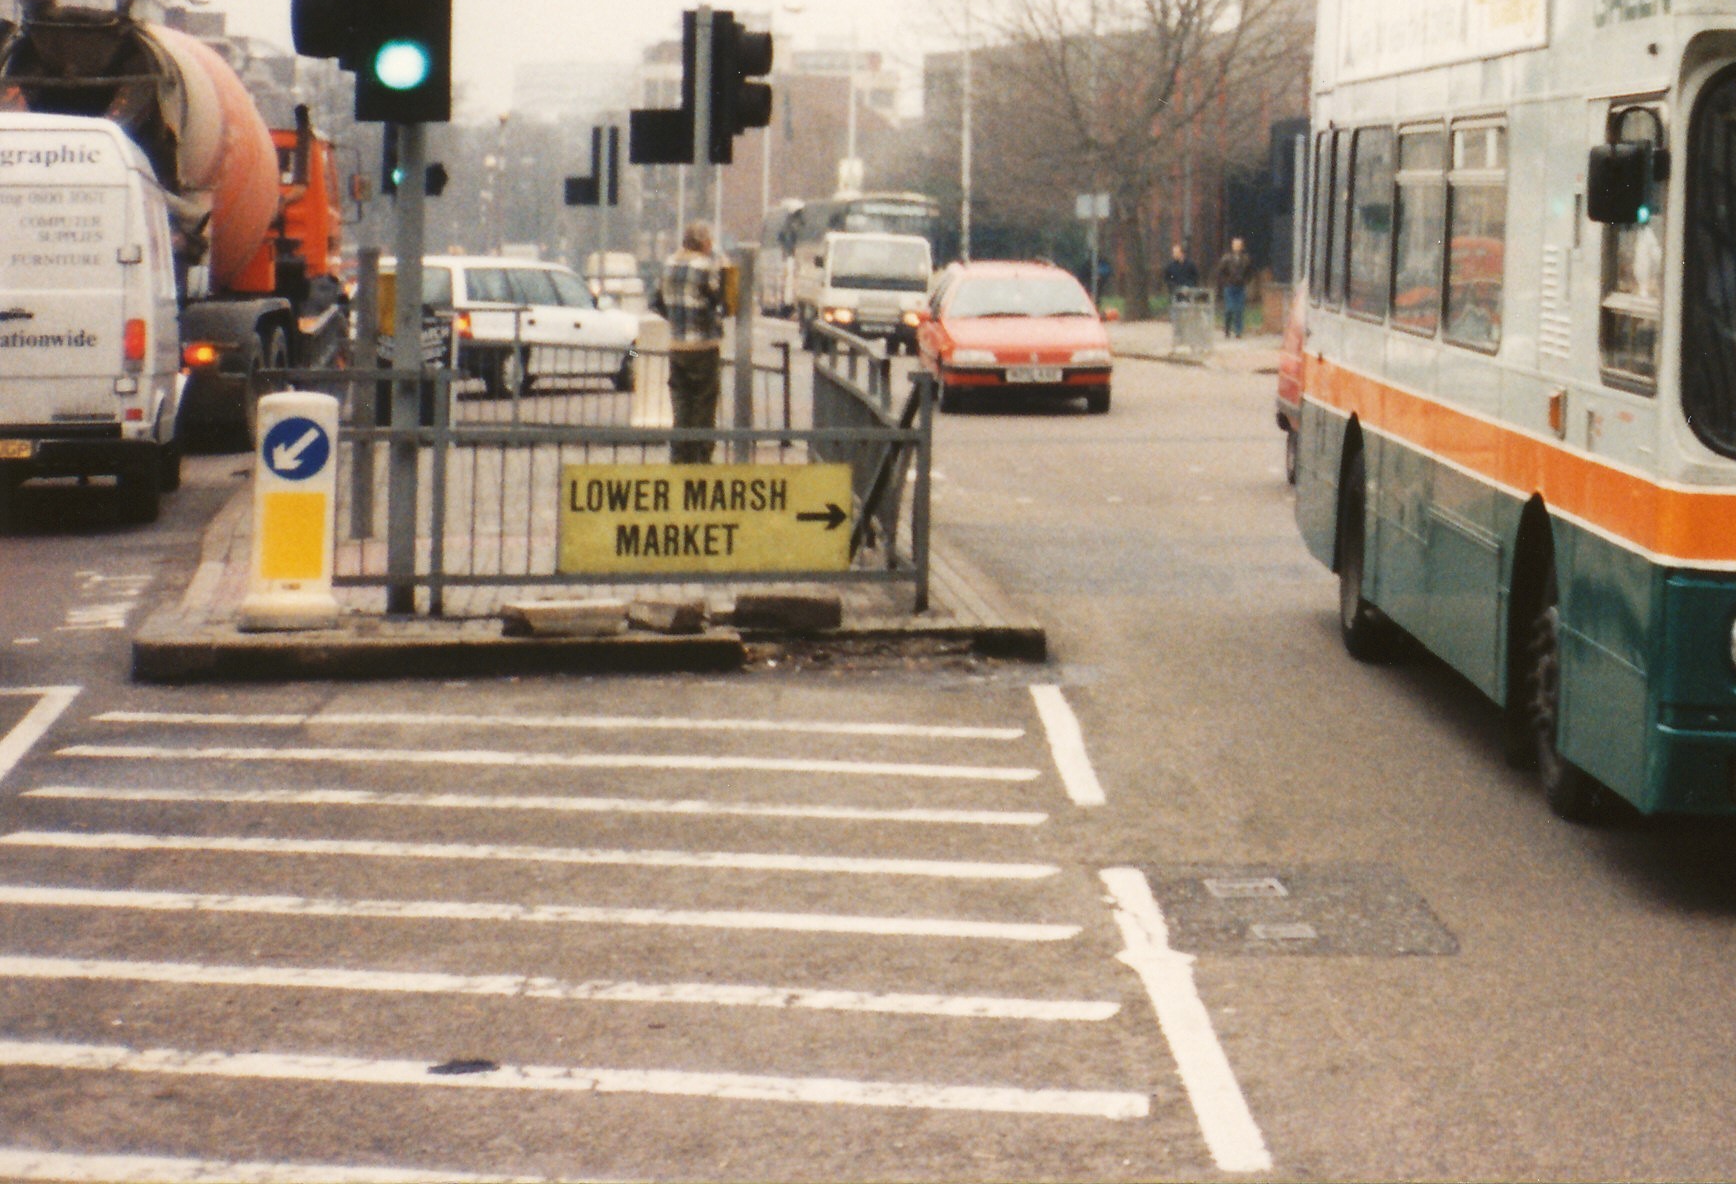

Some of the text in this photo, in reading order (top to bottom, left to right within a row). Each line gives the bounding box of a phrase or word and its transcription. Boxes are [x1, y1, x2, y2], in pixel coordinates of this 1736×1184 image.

[0, 145, 100, 167] graphic
[570, 479, 787, 513] LOWER MARSH
[615, 523, 739, 557] MARKET
